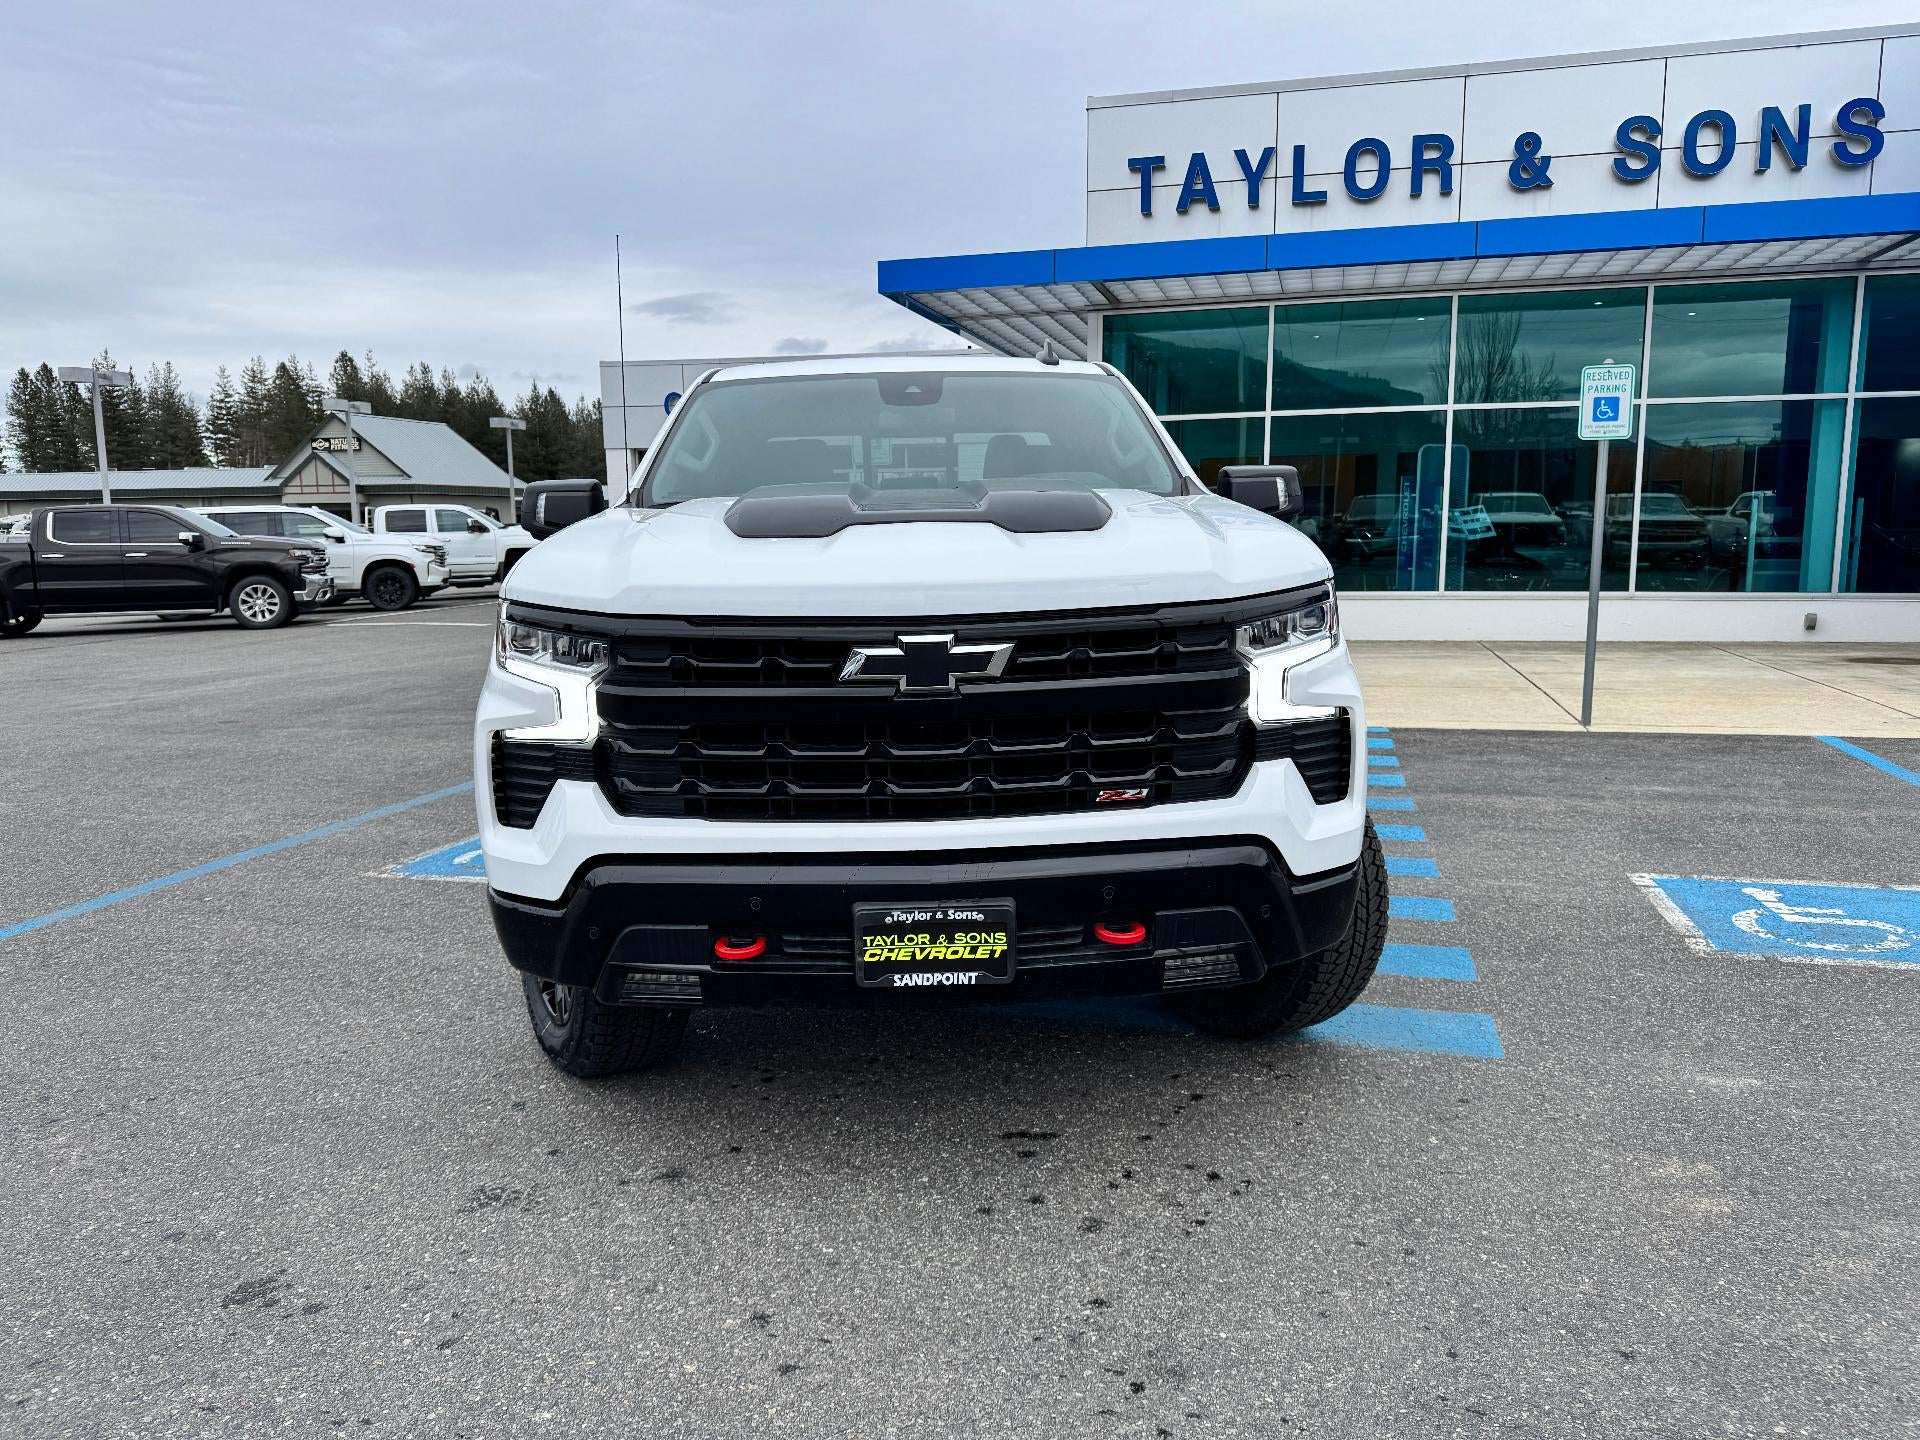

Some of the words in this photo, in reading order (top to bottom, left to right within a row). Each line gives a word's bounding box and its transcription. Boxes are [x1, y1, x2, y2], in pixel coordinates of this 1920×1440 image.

[1128, 133, 1455, 216] TAYLOR
[1507, 131, 1554, 190] &
[1611, 97, 1887, 183] SONS
[1586, 371, 1630, 381] RESERVED
[1587, 384, 1627, 394] PARKING
[891, 911, 932, 923] Taylor
[936, 911, 944, 919] &
[947, 910, 978, 920] Sons
[863, 934, 930, 946] TAYLOR
[936, 935, 949, 946] &
[954, 932, 1007, 944] SONS
[863, 946, 1007, 962] CHEVROLET
[893, 972, 979, 987] SANDPOINT
